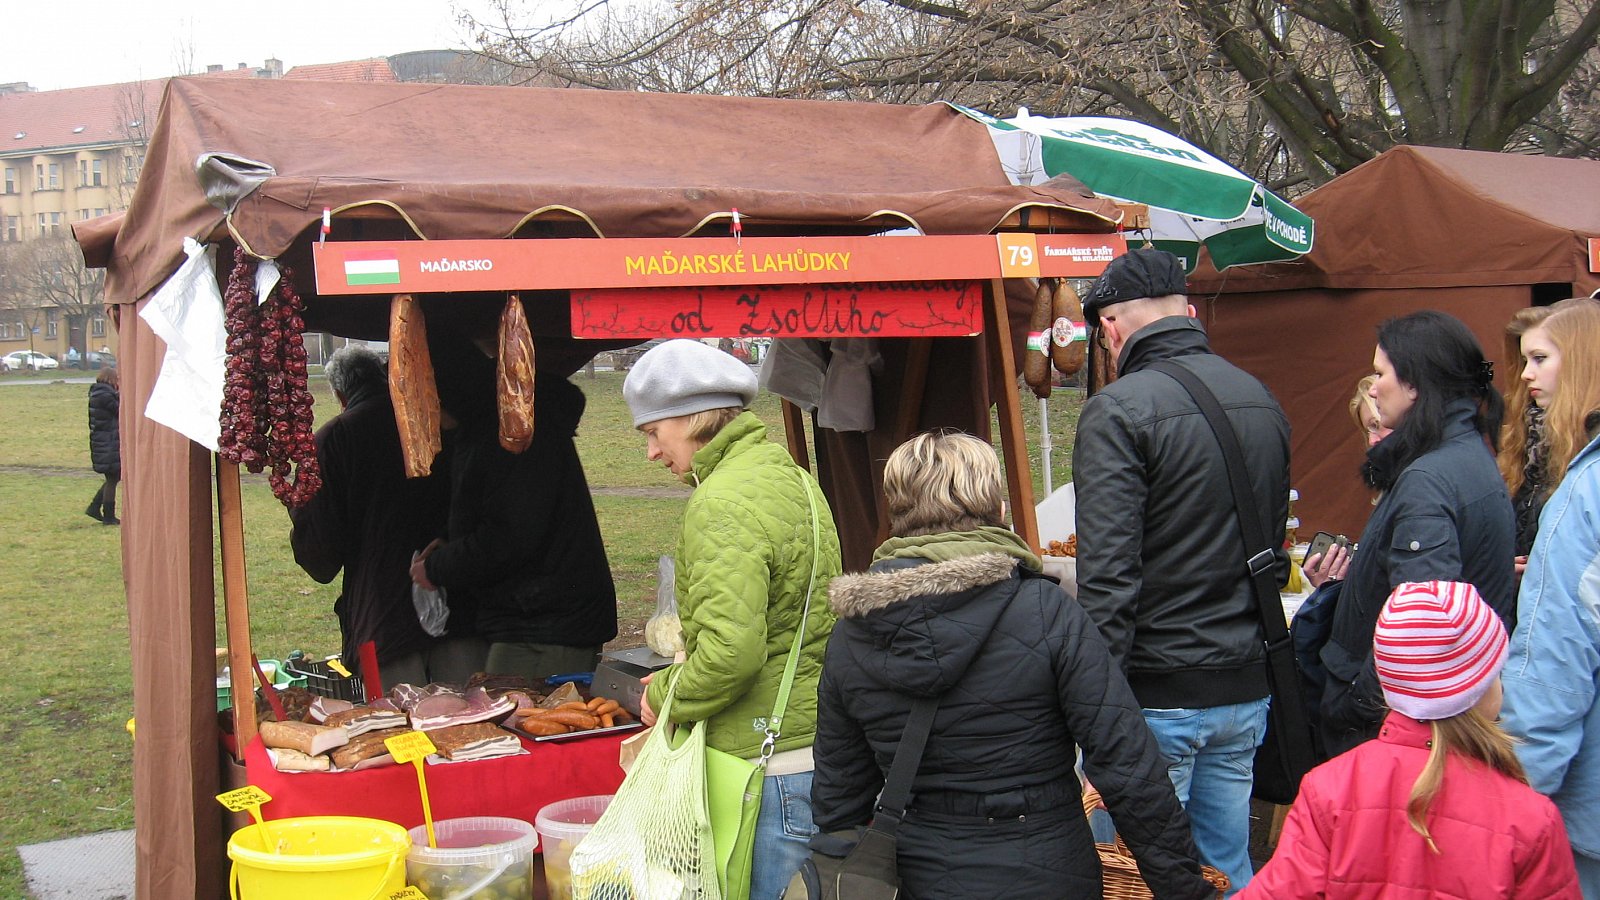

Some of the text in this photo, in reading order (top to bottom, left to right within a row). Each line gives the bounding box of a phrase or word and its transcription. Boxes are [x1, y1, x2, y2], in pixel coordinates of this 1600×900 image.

[1276, 218, 1308, 245] POHODĚ
[625, 247, 852, 276] MAĎARSKÉ LAHŮDKY
[1006, 245, 1034, 267] 79
[1044, 245, 1092, 256] FARMÁŘSKÉ
[420, 258, 493, 273] MAĎARSKO
[670, 293, 714, 334] od
